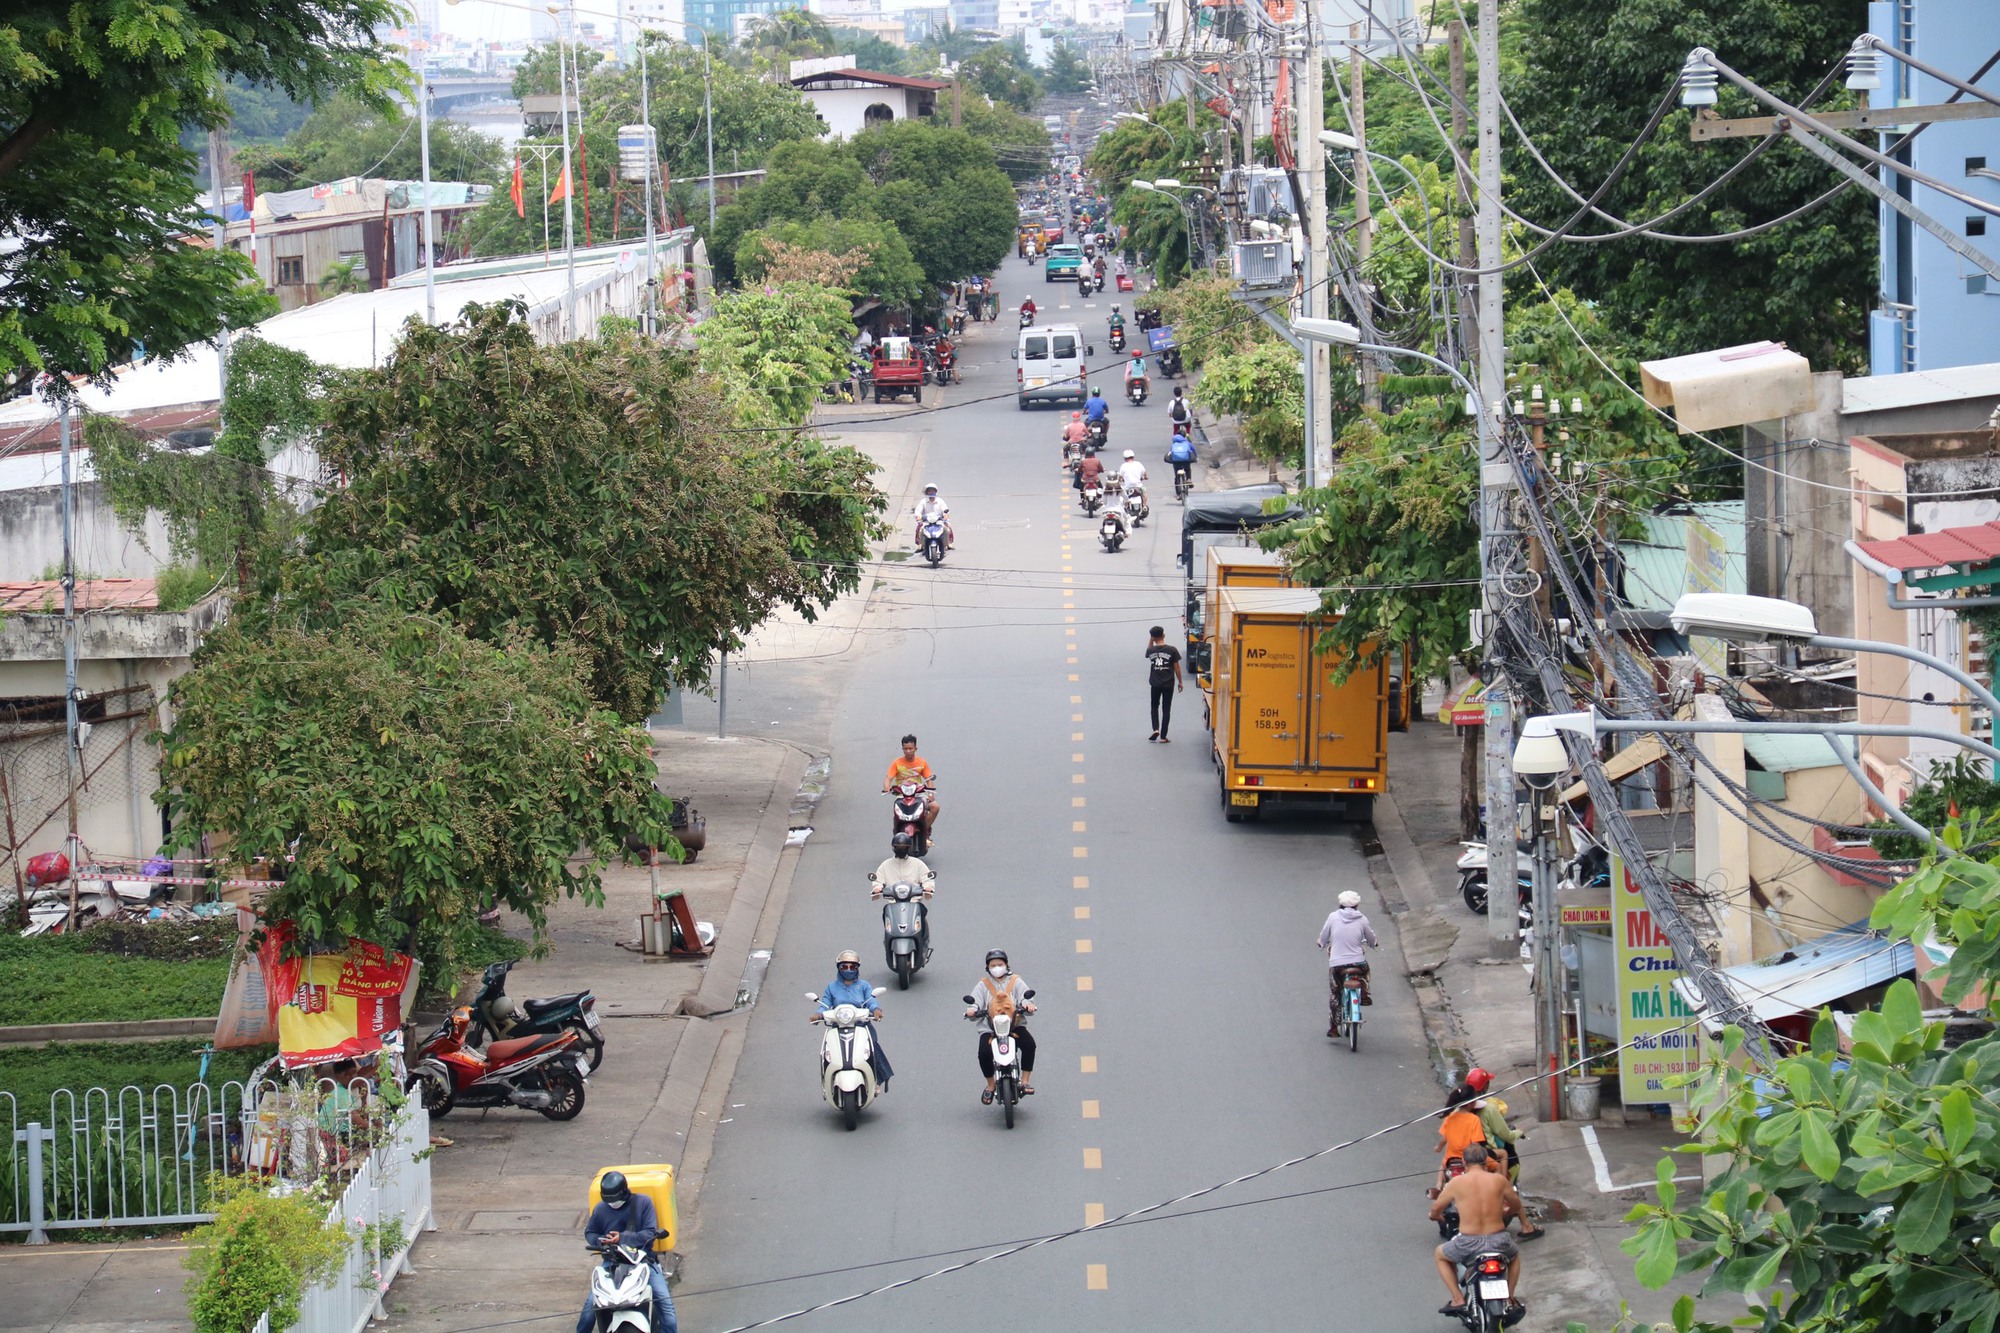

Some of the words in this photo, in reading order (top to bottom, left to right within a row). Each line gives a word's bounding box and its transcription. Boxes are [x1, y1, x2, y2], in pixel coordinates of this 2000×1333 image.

[1247, 648, 1267, 659] MP
[1267, 652, 1295, 660] logistics
[1260, 708, 1279, 718] 50H
[1255, 720, 1287, 730] 158.99
[375, 981, 399, 989] VIÊN
[299, 985, 309, 1012] MEIZAN
[1632, 985, 1664, 1018] MÁ
[1633, 1033, 1657, 1050] CÁC
